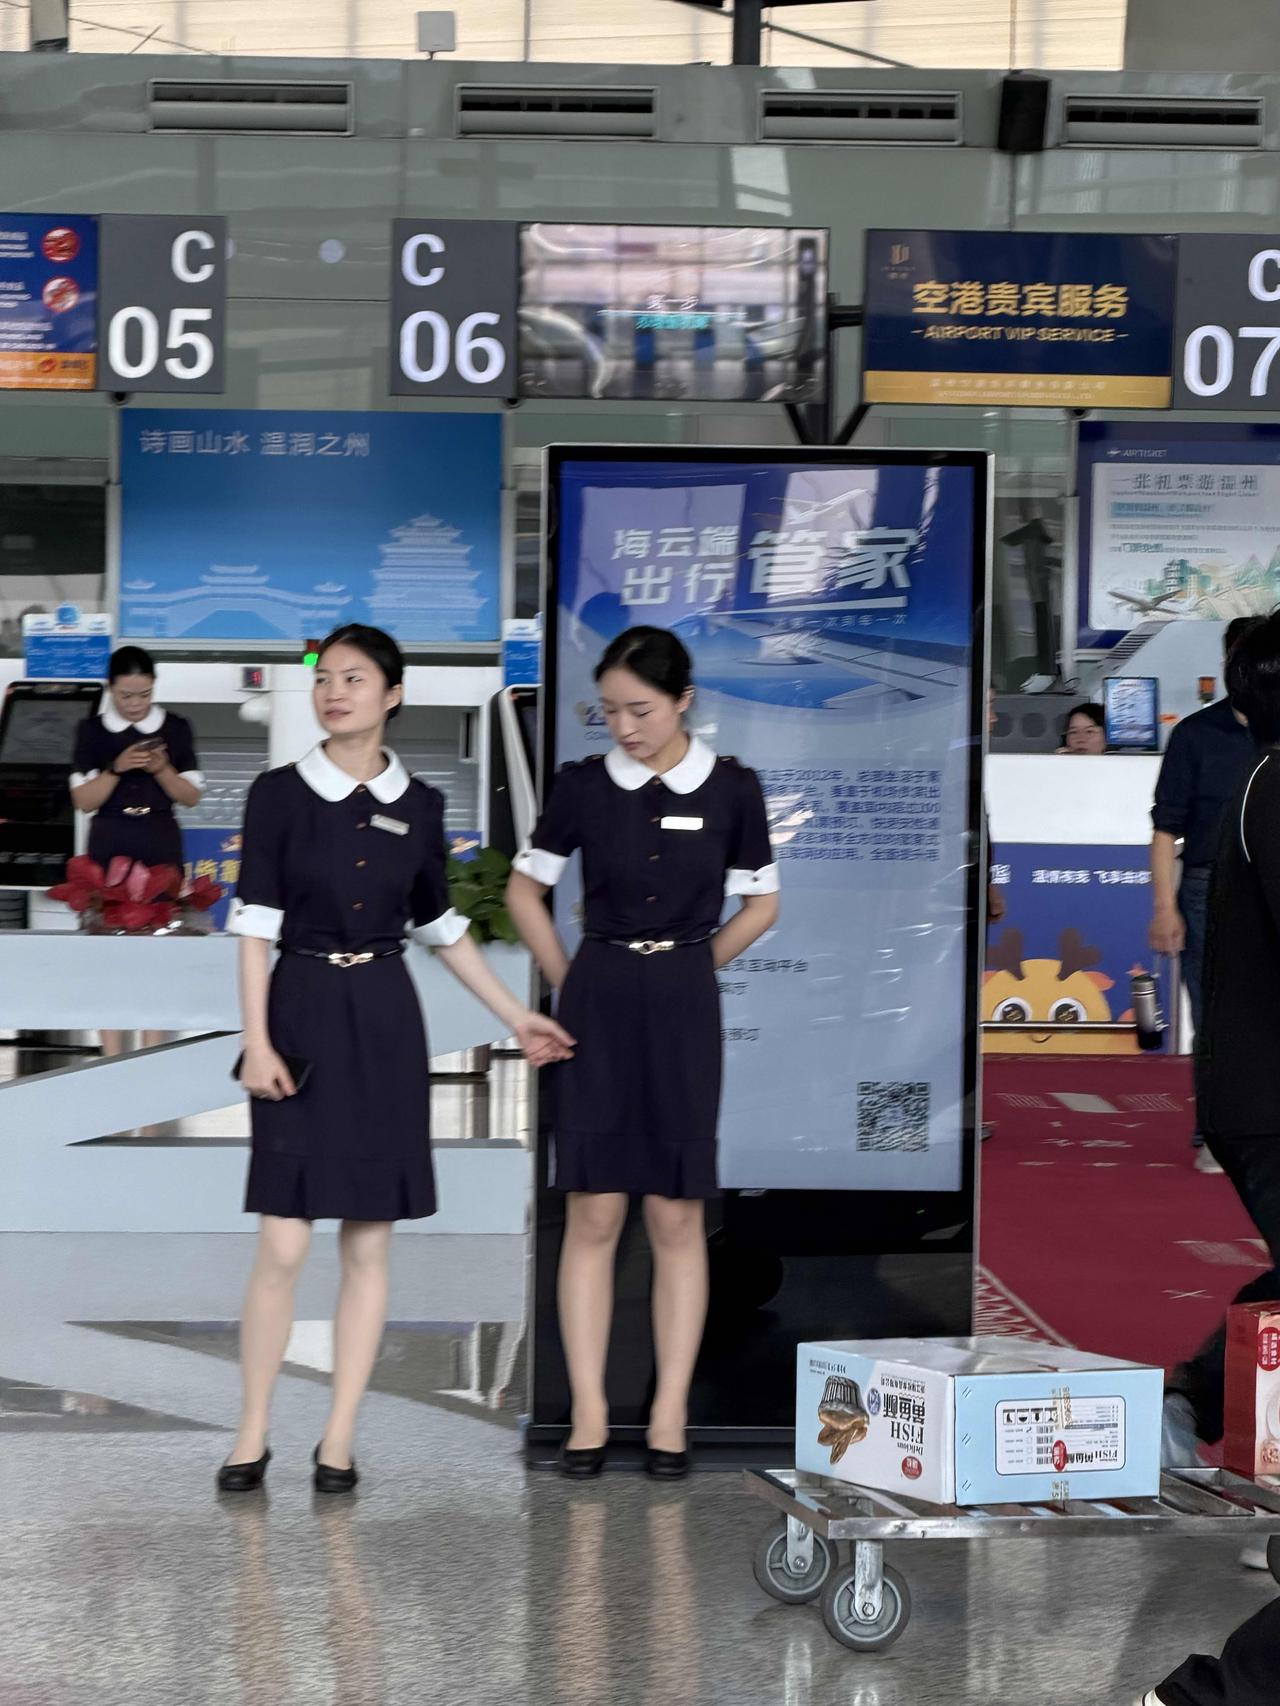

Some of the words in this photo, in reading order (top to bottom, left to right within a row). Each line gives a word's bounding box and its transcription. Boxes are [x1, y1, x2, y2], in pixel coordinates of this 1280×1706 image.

[172, 230, 215, 283] C
[401, 233, 446, 286] C
[1247, 249, 1280, 302] C
[912, 281, 1129, 318] 空港贵宾服务
[108, 306, 214, 379] 05
[400, 310, 506, 384] 06
[924, 325, 1004, 340] AIRPORT
[1005, 327, 1037, 340] VIP
[1037, 328, 1116, 342] SERVICE
[1184, 325, 1280, 397] 07
[139, 429, 250, 455] 诗画山水
[260, 431, 370, 457] 温润之州
[1111, 473, 1258, 491] 一张机票游温州
[611, 525, 739, 560] 海云端
[620, 561, 736, 606] 出行
[747, 526, 920, 601] 管家
[883, 1393, 925, 1424] 黄鱼酥
[890, 1420, 924, 1444] FiSH
[897, 1442, 924, 1456] Delicious
